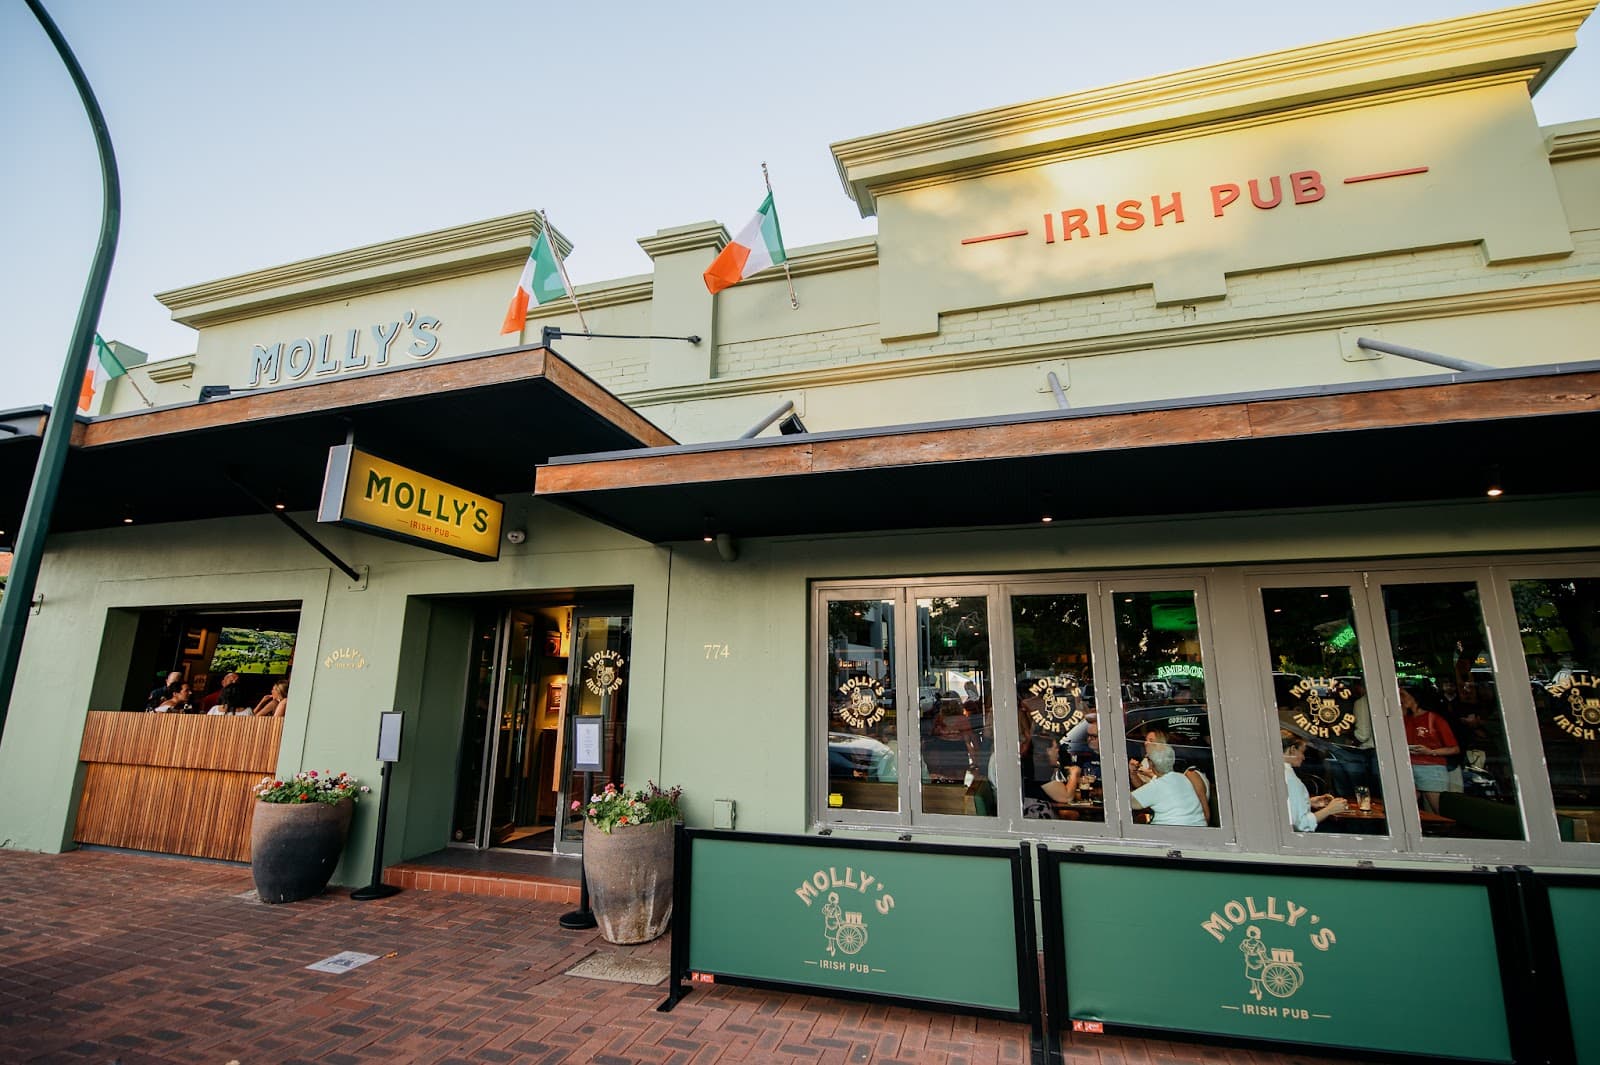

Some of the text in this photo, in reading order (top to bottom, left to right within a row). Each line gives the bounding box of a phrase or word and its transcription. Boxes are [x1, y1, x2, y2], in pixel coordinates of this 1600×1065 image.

[1043, 169, 1326, 245] IRISH PUB
[248, 309, 442, 387] MOLLY'S
[363, 467, 490, 535] MOLLY'S
[409, 520, 450, 538] IRISH PUB
[586, 649, 625, 667] MOLLY'S
[703, 644, 731, 660] 774
[585, 677, 623, 697] IRISH PUB
[839, 676, 886, 695] MOLLY'S
[1029, 675, 1082, 697] MOLLY'S
[1289, 676, 1352, 700] MOLLY'S
[839, 707, 885, 729] IRISH PUB
[1030, 710, 1084, 733] IRISH PUB
[1292, 713, 1356, 738] IRISH PUB
[1552, 714, 1596, 740] IRISH
[795, 866, 896, 915] MOLLY'S
[1200, 896, 1337, 952] MOLLY'S
[819, 959, 869, 974] IRISH PUB
[1242, 1003, 1310, 1020] IRISH PUB
